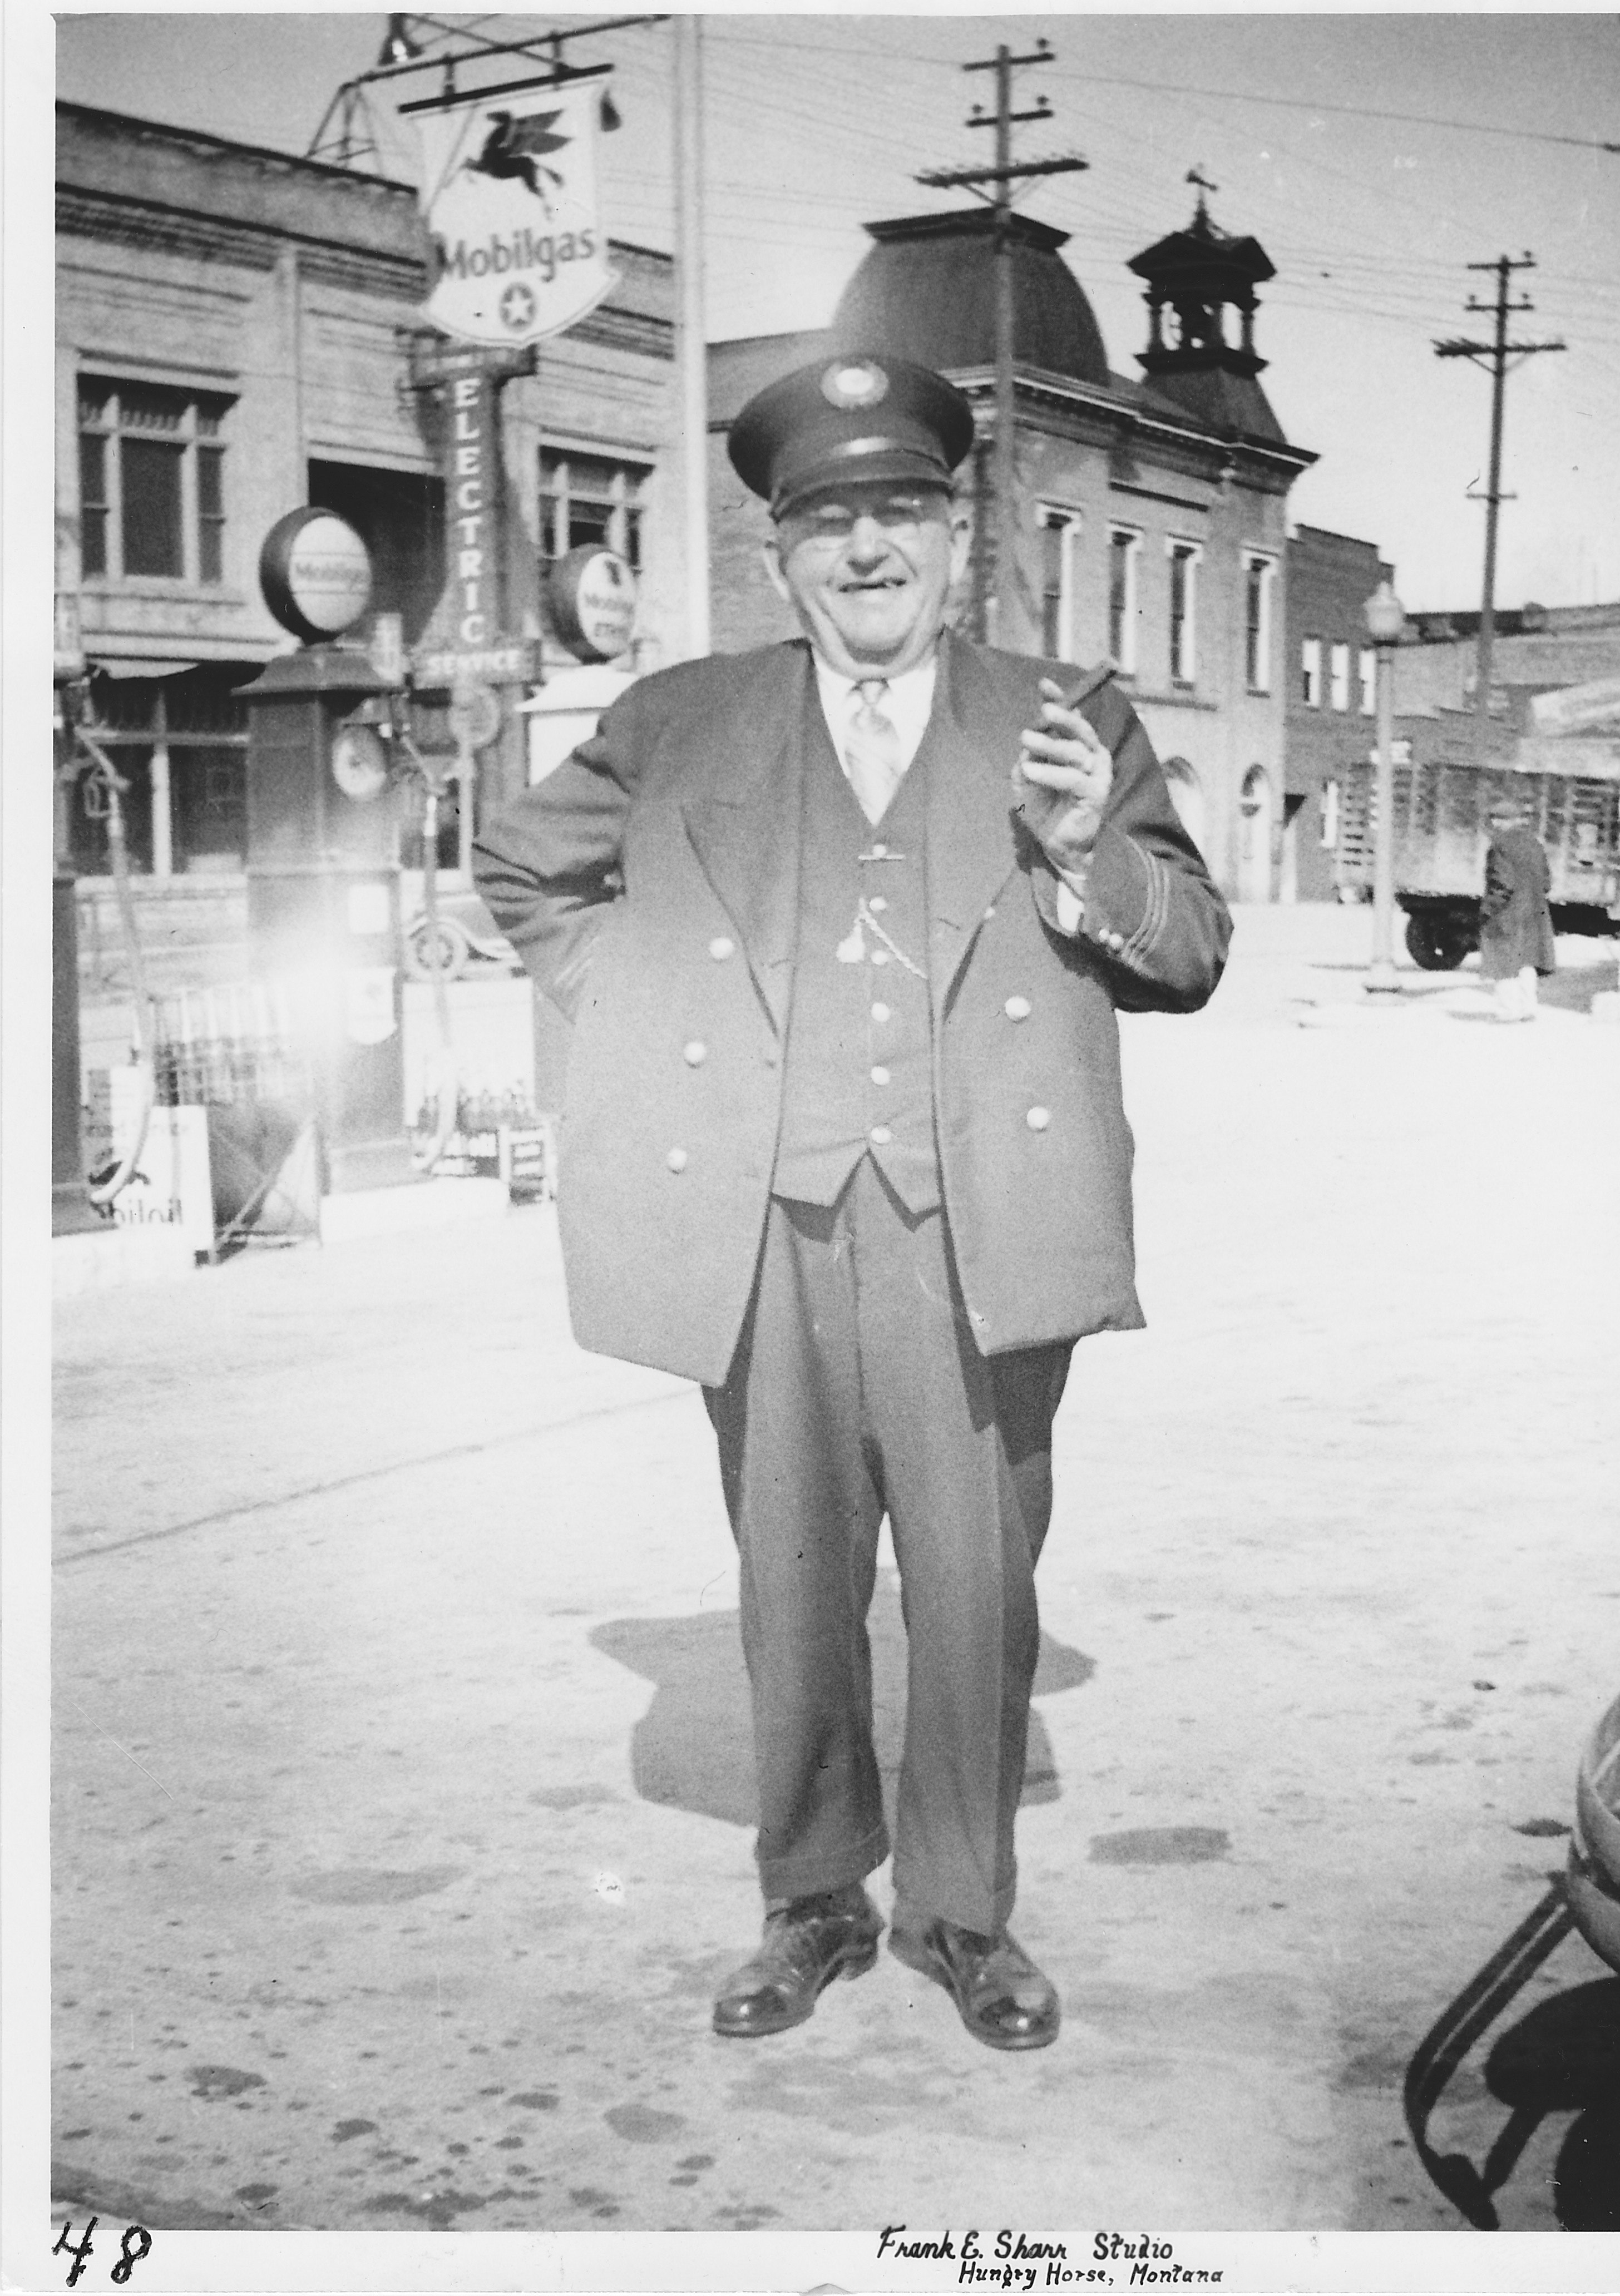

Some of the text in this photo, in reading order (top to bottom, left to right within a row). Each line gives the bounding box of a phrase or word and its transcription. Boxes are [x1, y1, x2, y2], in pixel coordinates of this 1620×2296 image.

[436, 227, 595, 283] Mobilgas
[453, 378, 486, 644] ELECTRIC
[426, 650, 520, 675] SERVICE
